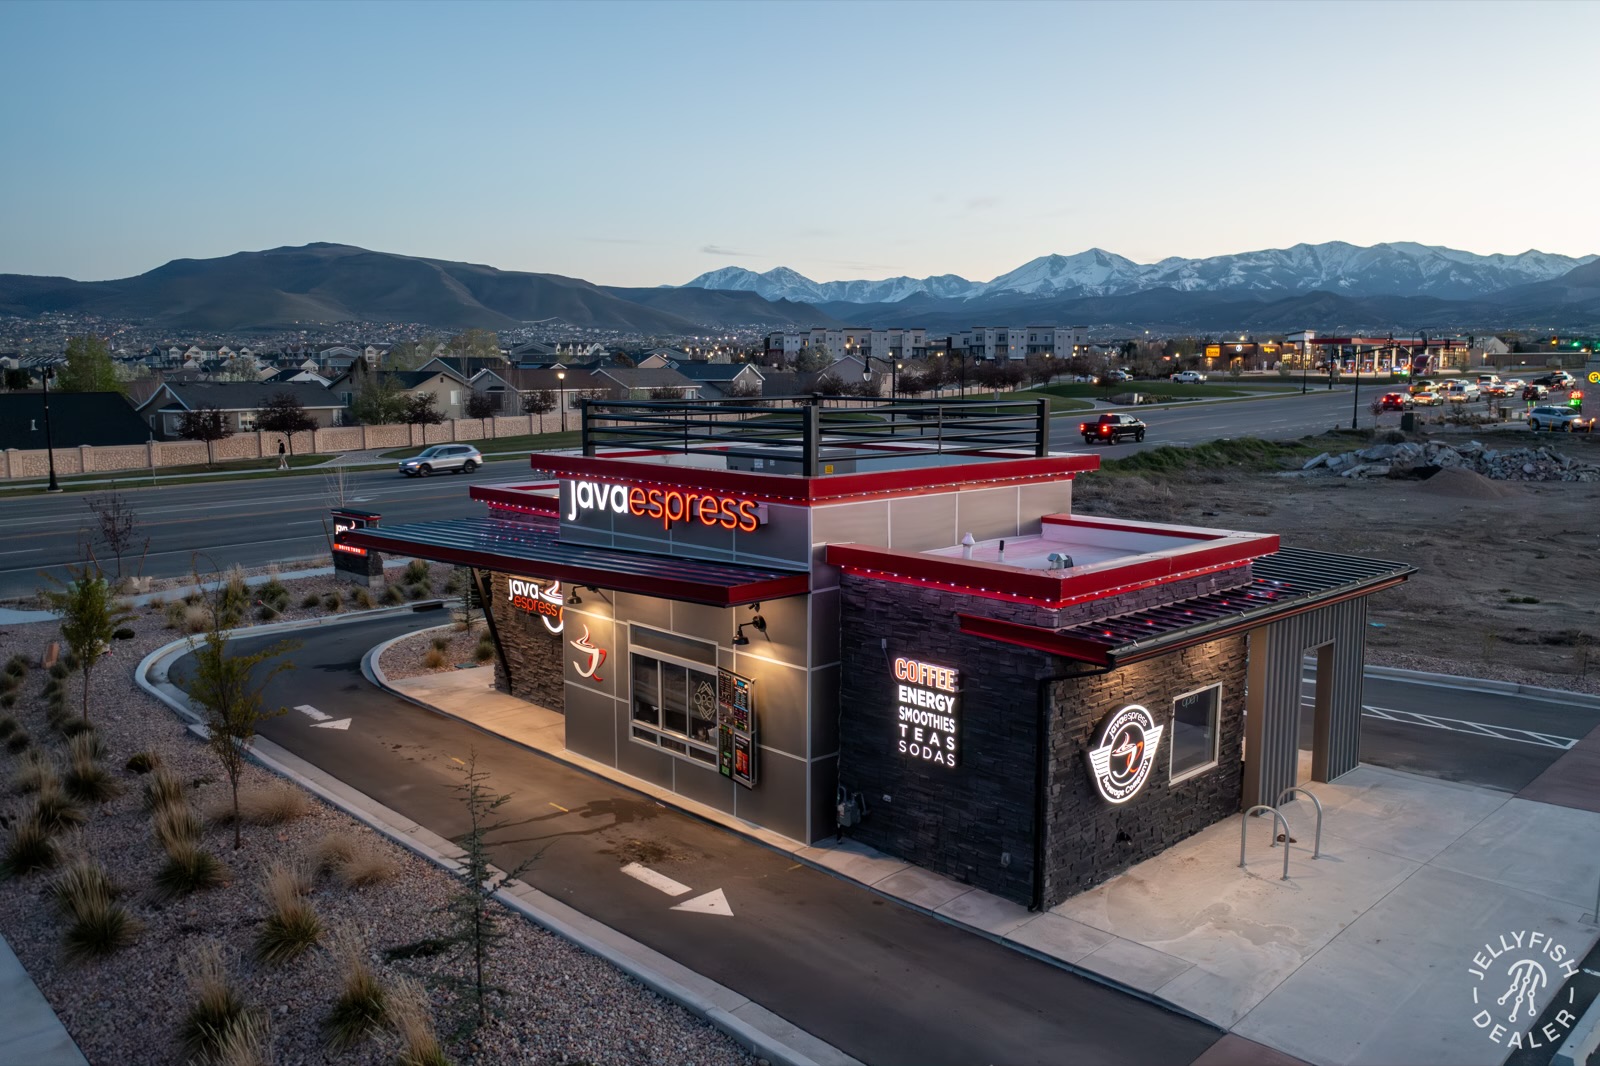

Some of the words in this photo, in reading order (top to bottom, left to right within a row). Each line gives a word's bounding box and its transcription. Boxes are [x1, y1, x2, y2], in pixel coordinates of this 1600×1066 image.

[508, 579, 539, 601] java
[514, 595, 558, 617] espress
[895, 658, 956, 692] COFFEE
[898, 684, 956, 714] ENERGY
[898, 706, 956, 734] SMOOTHIES
[898, 723, 956, 751] TEAS
[898, 740, 956, 767] SODAS
